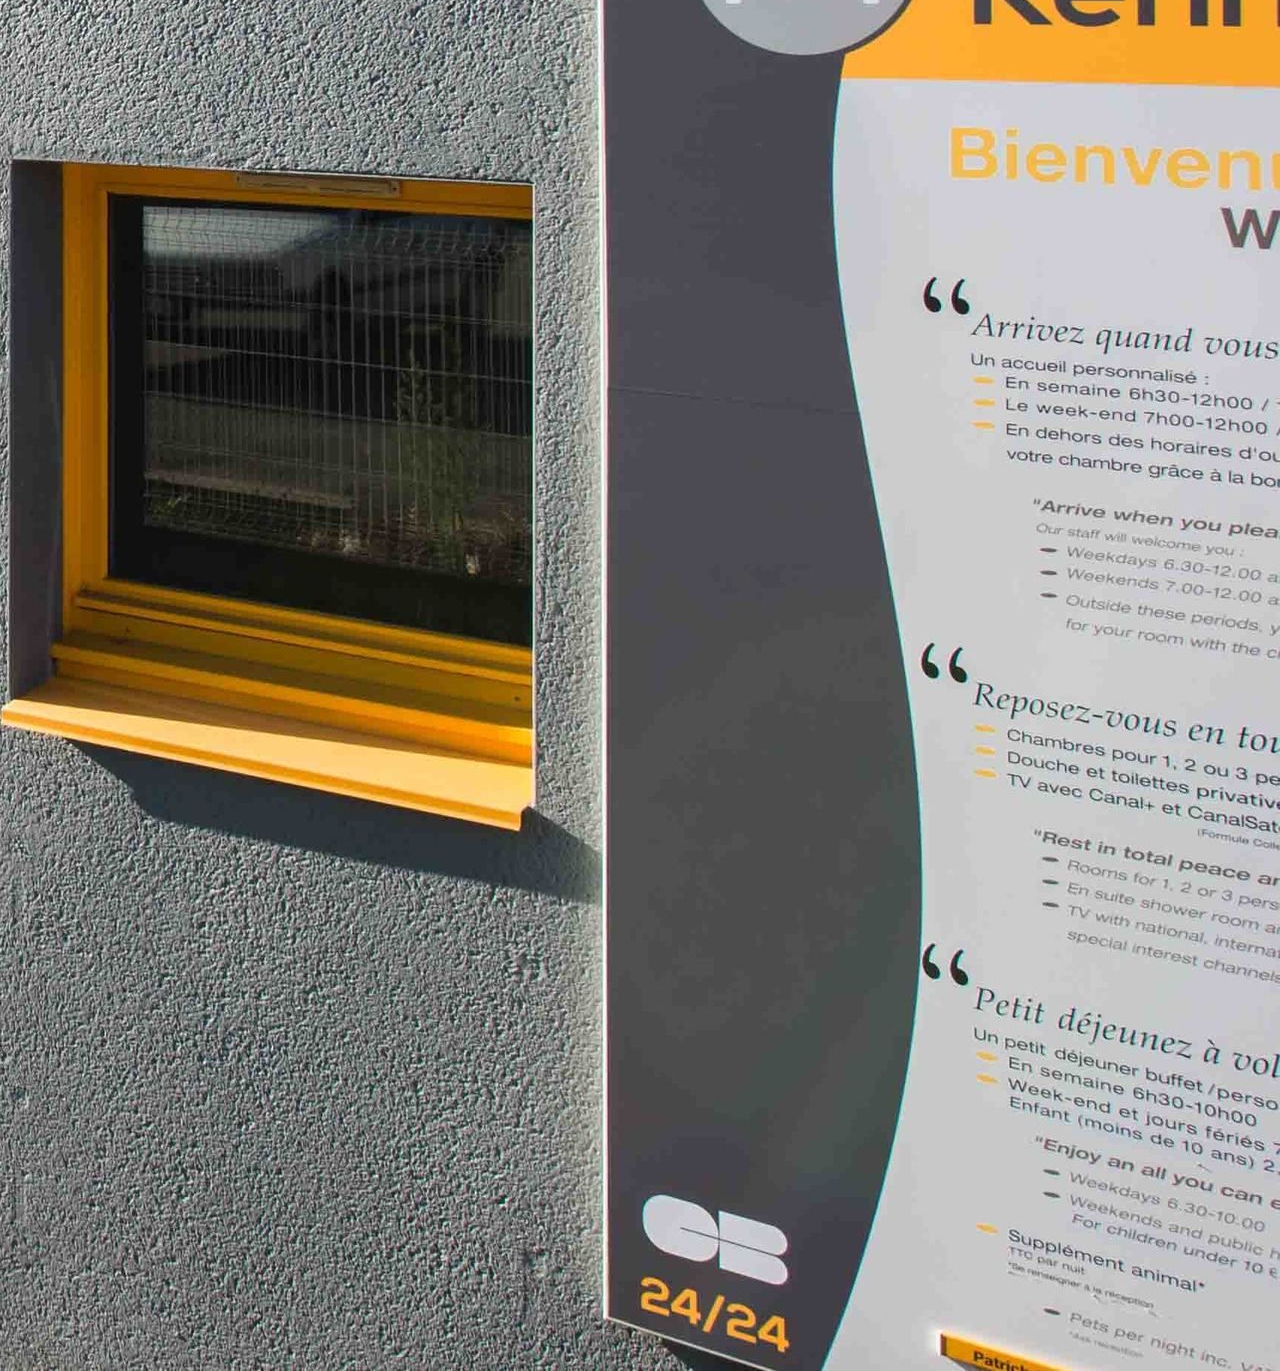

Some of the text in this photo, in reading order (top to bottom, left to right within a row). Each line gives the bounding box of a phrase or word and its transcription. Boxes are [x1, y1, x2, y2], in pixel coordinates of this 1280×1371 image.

[971, 313, 1280, 360] Arrivez quand vous
[971, 353, 1197, 384] Un accueil personnalisé
[1005, 377, 1253, 410] En semaine 6h30-12h00
[1005, 398, 1028, 412] Le
[1037, 403, 1137, 422] week-end
[1143, 412, 1267, 435] 7h00-12h00
[1005, 423, 1029, 437] En
[1036, 426, 1102, 445] dehors
[1109, 433, 1144, 449] des
[1151, 438, 1232, 458] horaires
[1006, 449, 1053, 464] votre
[1058, 452, 1142, 473] chambre
[1148, 463, 1204, 480] grâce
[1210, 469, 1222, 482] à
[1229, 470, 1243, 484] la
[1033, 498, 1106, 518] "Arrive
[1114, 509, 1173, 526] when
[1180, 517, 1222, 533] you
[1036, 523, 1235, 556] Our staff will welcome you
[1067, 546, 1157, 569] Weekdays
[1164, 559, 1262, 581] 6.30-12.00
[1067, 568, 1159, 590] Weekends
[1166, 581, 1262, 603] 7.00-12.00
[1066, 594, 1132, 614] Outside
[1138, 605, 1186, 621] these
[1066, 619, 1088, 631] for
[1093, 624, 1133, 638] your
[1138, 630, 1184, 645] room
[1190, 637, 1226, 651] with
[1232, 643, 1260, 656] the
[973, 682, 1177, 737] Reposez-vous
[1188, 723, 1224, 745] en
[1007, 729, 1105, 757] Chambres
[1112, 748, 1157, 766] pour
[1185, 758, 1196, 772] 2
[1203, 764, 1229, 777] ou
[1235, 767, 1248, 780] 3
[1007, 751, 1079, 775] Douche
[1086, 764, 1105, 779] et
[1111, 770, 1189, 794] toilettes
[1007, 773, 1032, 788] TV
[1037, 781, 1083, 799] avec
[1089, 788, 1155, 811] Canal+
[1162, 802, 1180, 816] et
[1034, 829, 1091, 851] "Rest
[1098, 841, 1116, 856] in
[1124, 846, 1173, 866] total
[1178, 857, 1251, 881] peace
[1067, 859, 1127, 881] Rooms
[1133, 872, 1154, 887] for
[1180, 881, 1192, 894] 2
[1197, 887, 1217, 898] or
[1221, 890, 1233, 901] 3
[1067, 881, 1089, 896] En
[1094, 886, 1135, 906] suite
[1139, 897, 1206, 919] shower
[1210, 913, 1259, 930] room
[1067, 904, 1090, 918] TV
[1095, 911, 1130, 928] with
[1066, 929, 1127, 951] special
[1131, 941, 1198, 967] interest
[973, 986, 1045, 1025] Petit
[1058, 1007, 1193, 1059] déjeunez
[1203, 1038, 1220, 1065] à
[973, 1027, 998, 1045] Un
[1005, 1035, 1047, 1056] petit
[1055, 1046, 1140, 1077] déjeuner
[1145, 1067, 1203, 1093] buffet
[1008, 1056, 1257, 1127] En semaine 6h30-10h00
[1008, 1076, 1111, 1114] Week-end
[1119, 1106, 1139, 1121] et
[1144, 1112, 1197, 1135] jours
[1206, 1125, 1265, 1152] fériés
[1010, 1096, 1070, 1123] Enfant
[1078, 1114, 1143, 1141] (moins
[1150, 1133, 1174, 1148] de
[1182, 1140, 1203, 1155] 10
[1211, 1149, 1254, 1169] ans)
[1035, 1135, 1101, 1165] "Enjoy
[1107, 1156, 1134, 1172] an
[1140, 1164, 1166, 1180] all
[1171, 1172, 1214, 1193] you
[1220, 1185, 1263, 1205] can
[1069, 1172, 1161, 1206] Weekdays
[1069, 1194, 1163, 1229] Weekends
[1168, 1221, 1203, 1240] and
[1207, 1233, 1264, 1257] public
[1071, 1213, 1101, 1230] For
[1106, 1223, 1177, 1252] children
[1183, 1245, 1237, 1267] under
[1244, 1260, 1263, 1275] 10
[1008, 1228, 1126, 1272] Supplément
[1008, 1246, 1086, 1275] TTC par nuit
[640, 1276, 790, 1354] 24/24
[1069, 1312, 1110, 1333] Pets
[1114, 1328, 1144, 1343] per
[1151, 1335, 1195, 1361] night
